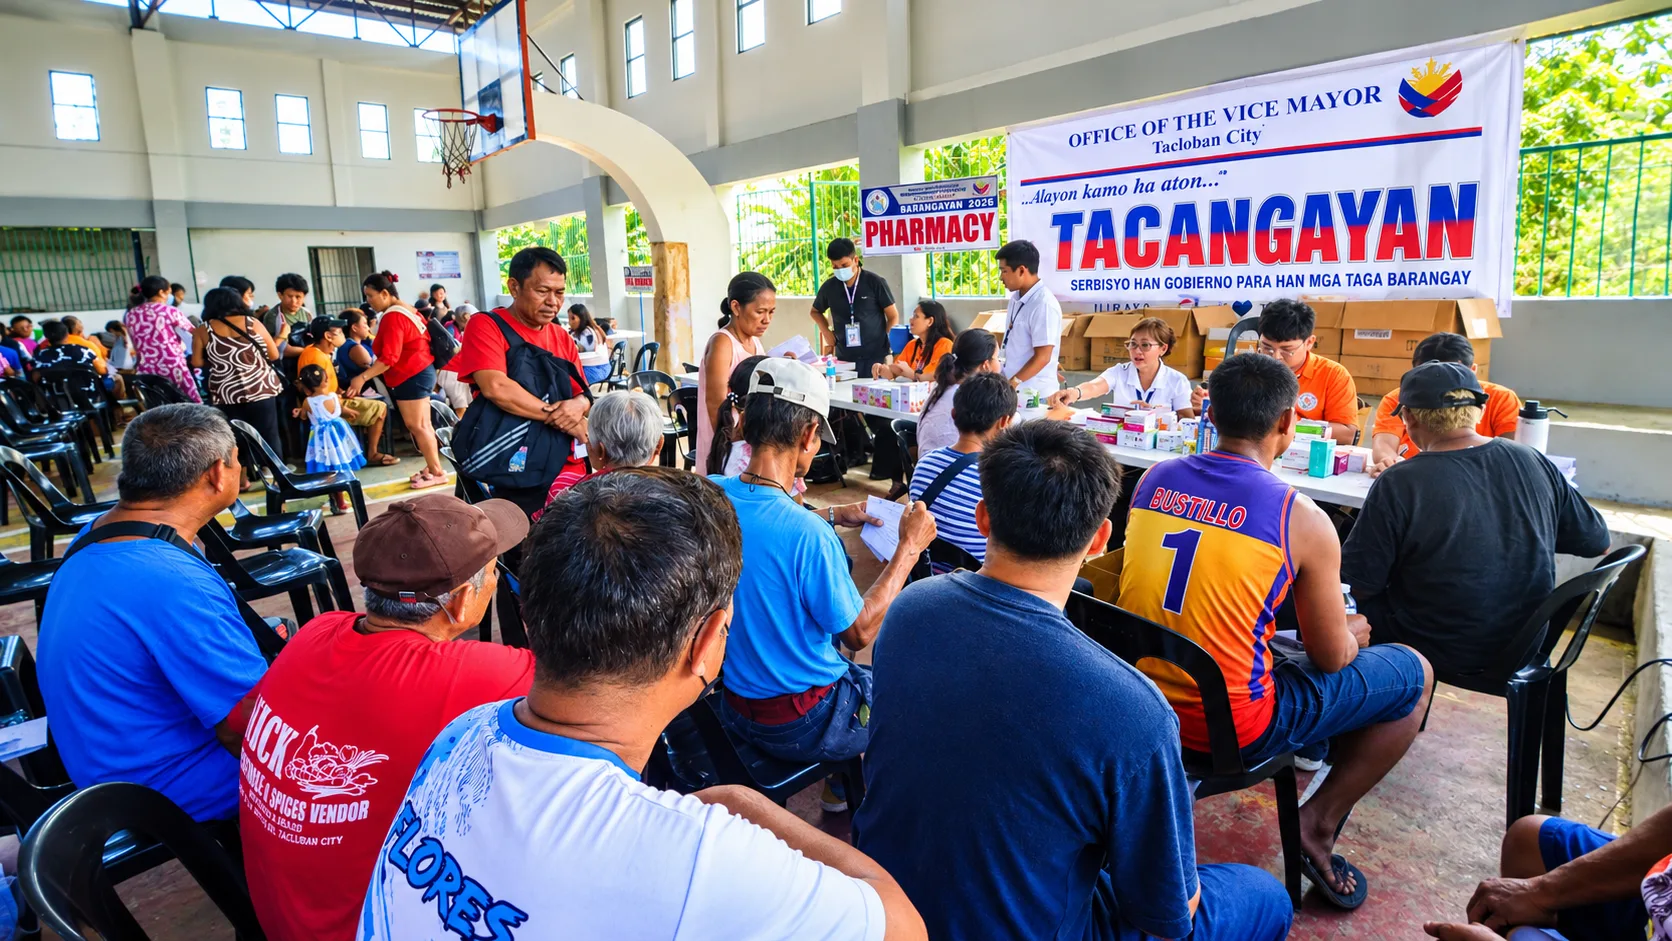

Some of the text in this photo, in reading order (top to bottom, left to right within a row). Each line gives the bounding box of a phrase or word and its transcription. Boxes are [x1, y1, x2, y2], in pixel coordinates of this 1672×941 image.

[1068, 85, 1382, 148] OFFICE OF THE VICE MAYOR
[1152, 128, 1262, 154] Tacloban City
[900, 201, 963, 214] BARANGAYAN
[968, 197, 994, 209] 2026
[1082, 183, 1128, 200] kamo
[1133, 178, 1155, 195] ha
[865, 211, 995, 248] PHARMACY
[1050, 181, 1480, 272] TACANGAYAN
[1070, 270, 1472, 291] SERBISYO HAN GOBIERNO PARA HAN MGA TAGA BARANGAY
[1149, 486, 1247, 530] BUSTILLO
[1160, 527, 1203, 616] 1
[269, 788, 307, 821] SPICES
[309, 800, 370, 824] VENDOR
[320, 835, 343, 846] CITY
[384, 799, 529, 941] FLORES
